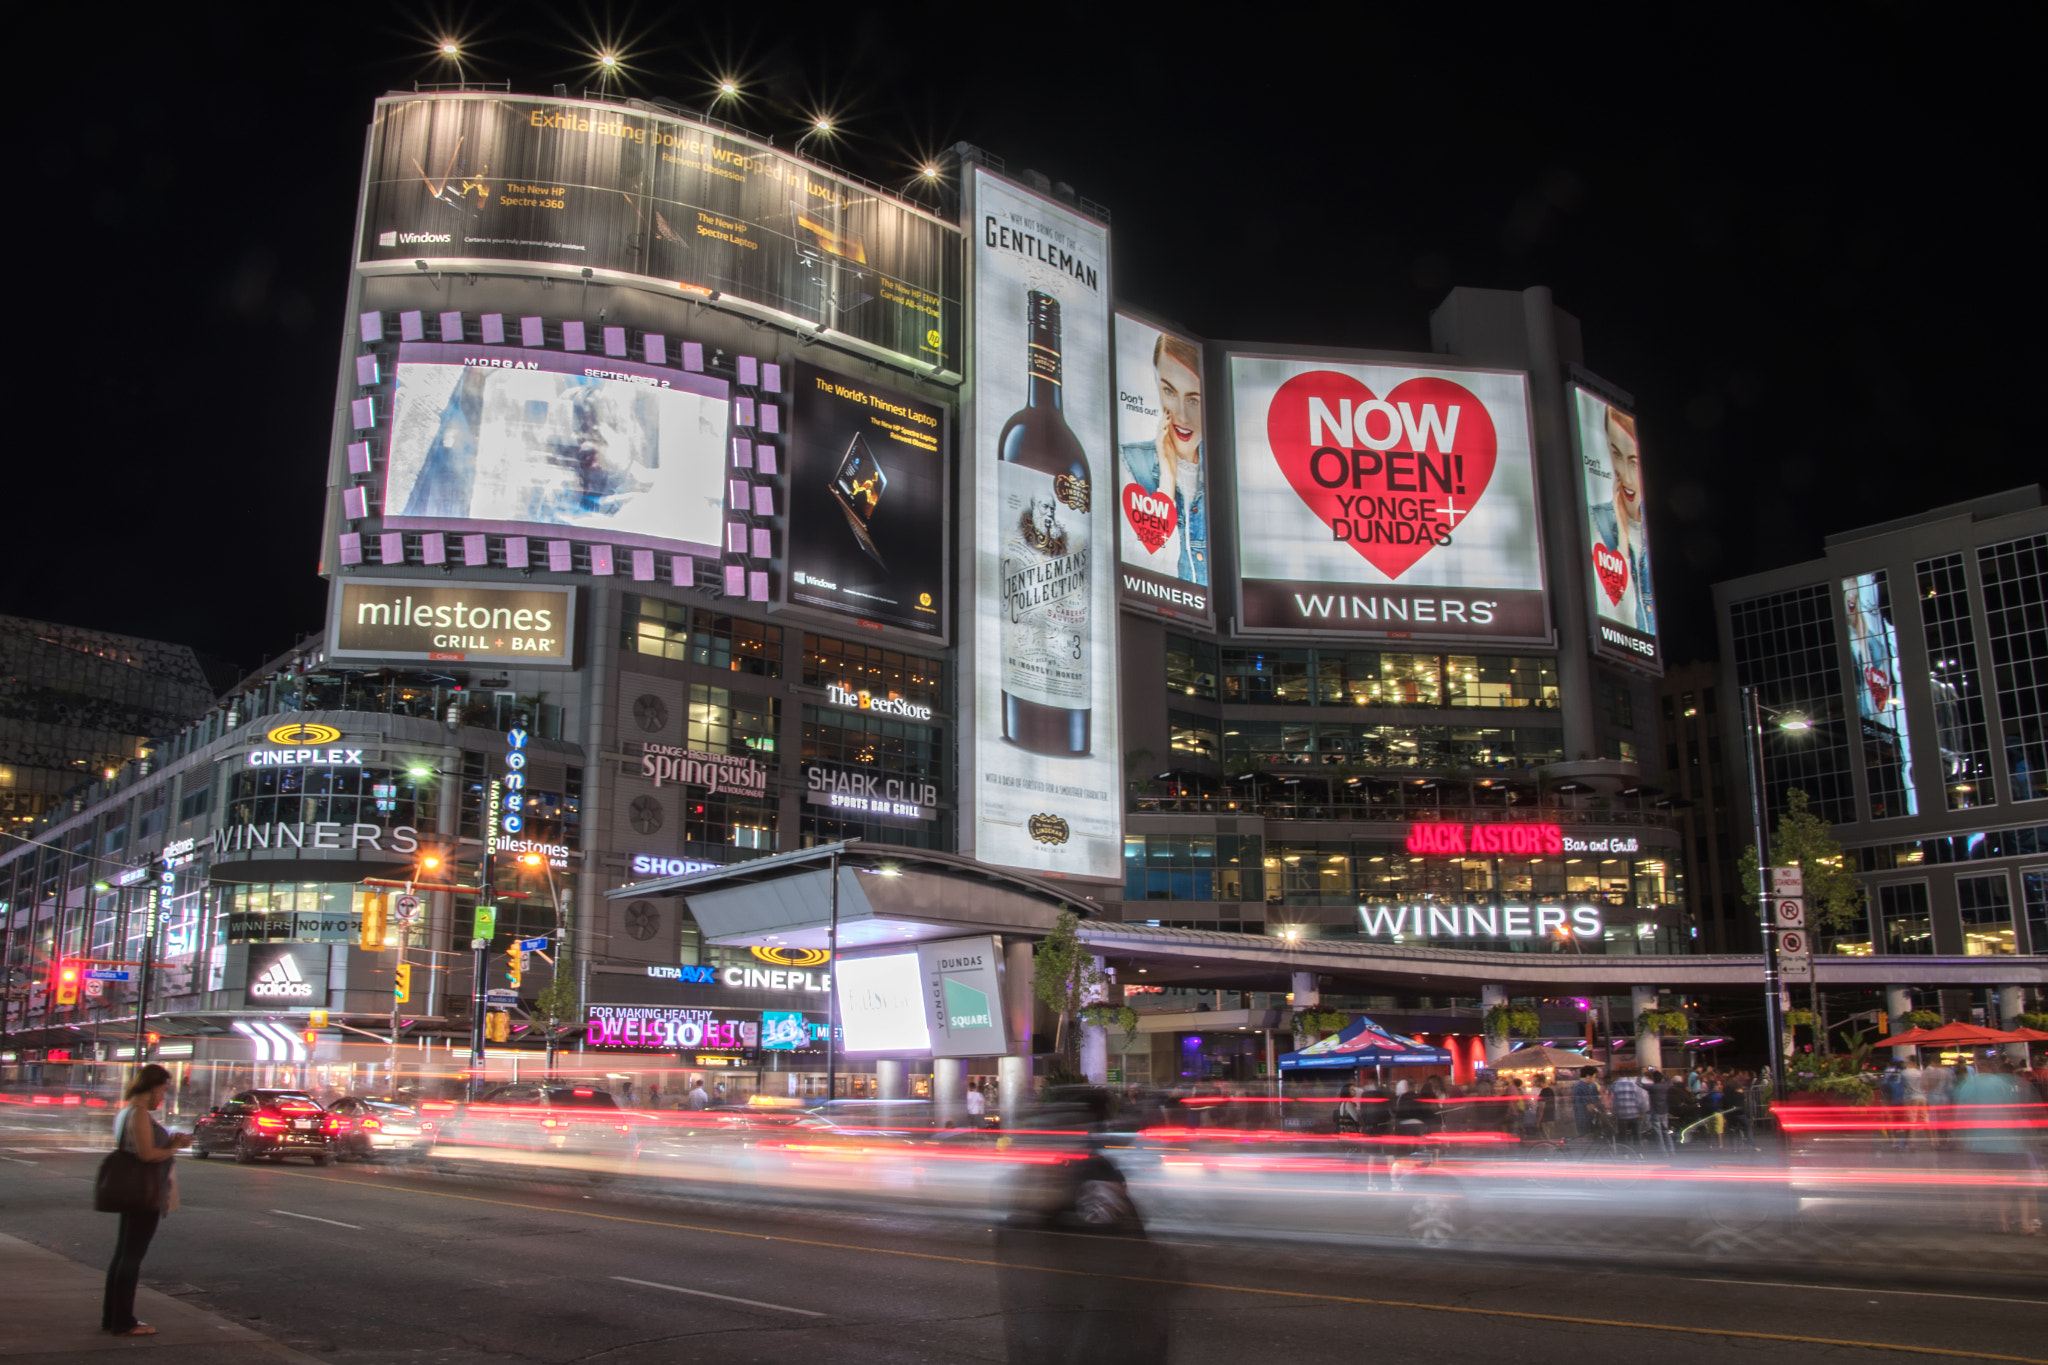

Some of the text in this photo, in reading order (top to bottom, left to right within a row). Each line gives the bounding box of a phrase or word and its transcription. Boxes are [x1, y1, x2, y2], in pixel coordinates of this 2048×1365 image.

[531, 111, 850, 210] Exhilarating power wrapped in luxury
[662, 152, 746, 183] Reinvent Obsession
[500, 195, 565, 209] Spectre x360
[507, 183, 566, 196] The New HP
[697, 212, 747, 233] The New HP
[399, 231, 451, 244] Windows
[697, 224, 758, 250] Spectre Laptop
[881, 277, 894, 289] The
[895, 283, 910, 295] New
[911, 288, 921, 299] HP
[880, 288, 940, 318] Curved All-in-One
[464, 357, 671, 389] MORGAN SEPTEMBER 2
[816, 377, 938, 428] The World's Thinnest Laptop
[1120, 391, 1143, 405] Don't
[1308, 396, 1461, 454] NOW
[1309, 446, 1466, 495] OPEN!
[1131, 491, 1169, 519] NOW
[1132, 509, 1169, 533] OPEN!
[1332, 517, 1453, 547] DUNDAS
[1598, 550, 1623, 575] NOW
[806, 575, 837, 590] Windows
[1123, 574, 1206, 610] WINNERS
[1011, 568, 1085, 624] COLLECTION
[1295, 593, 1496, 625] WINNERS
[358, 596, 552, 631] milestones
[433, 634, 489, 649] GRILL
[511, 637, 552, 651] BAR
[1601, 626, 1654, 656] WINNERS
[250, 749, 362, 766] CINEPLEX
[643, 742, 748, 767] LOUNGE RESTAURANT
[807, 766, 937, 807] SHARK CLUB
[487, 779, 500, 856] DOWNTOWN
[831, 794, 920, 817] SPORTS BAR GRILL
[213, 821, 419, 853] WINNERS
[1407, 823, 1638, 854] JACK ASTOR'S Bar and Grill
[549, 858, 568, 868] BAR
[146, 889, 157, 938] DOWNTOWN
[232, 921, 291, 931] WINNERS
[299, 920, 333, 931] NOW
[1359, 905, 1601, 937] WINNERS
[647, 965, 716, 984] ULTRA AVX
[941, 956, 982, 969] DUNDAS
[252, 981, 313, 997] adidas
[589, 1006, 713, 1021] FOR MAKING HEALTHY
[932, 980, 945, 1029] YONGE
[601, 1017, 719, 1038] WELCOME
[951, 1014, 989, 1028] SQUARE
